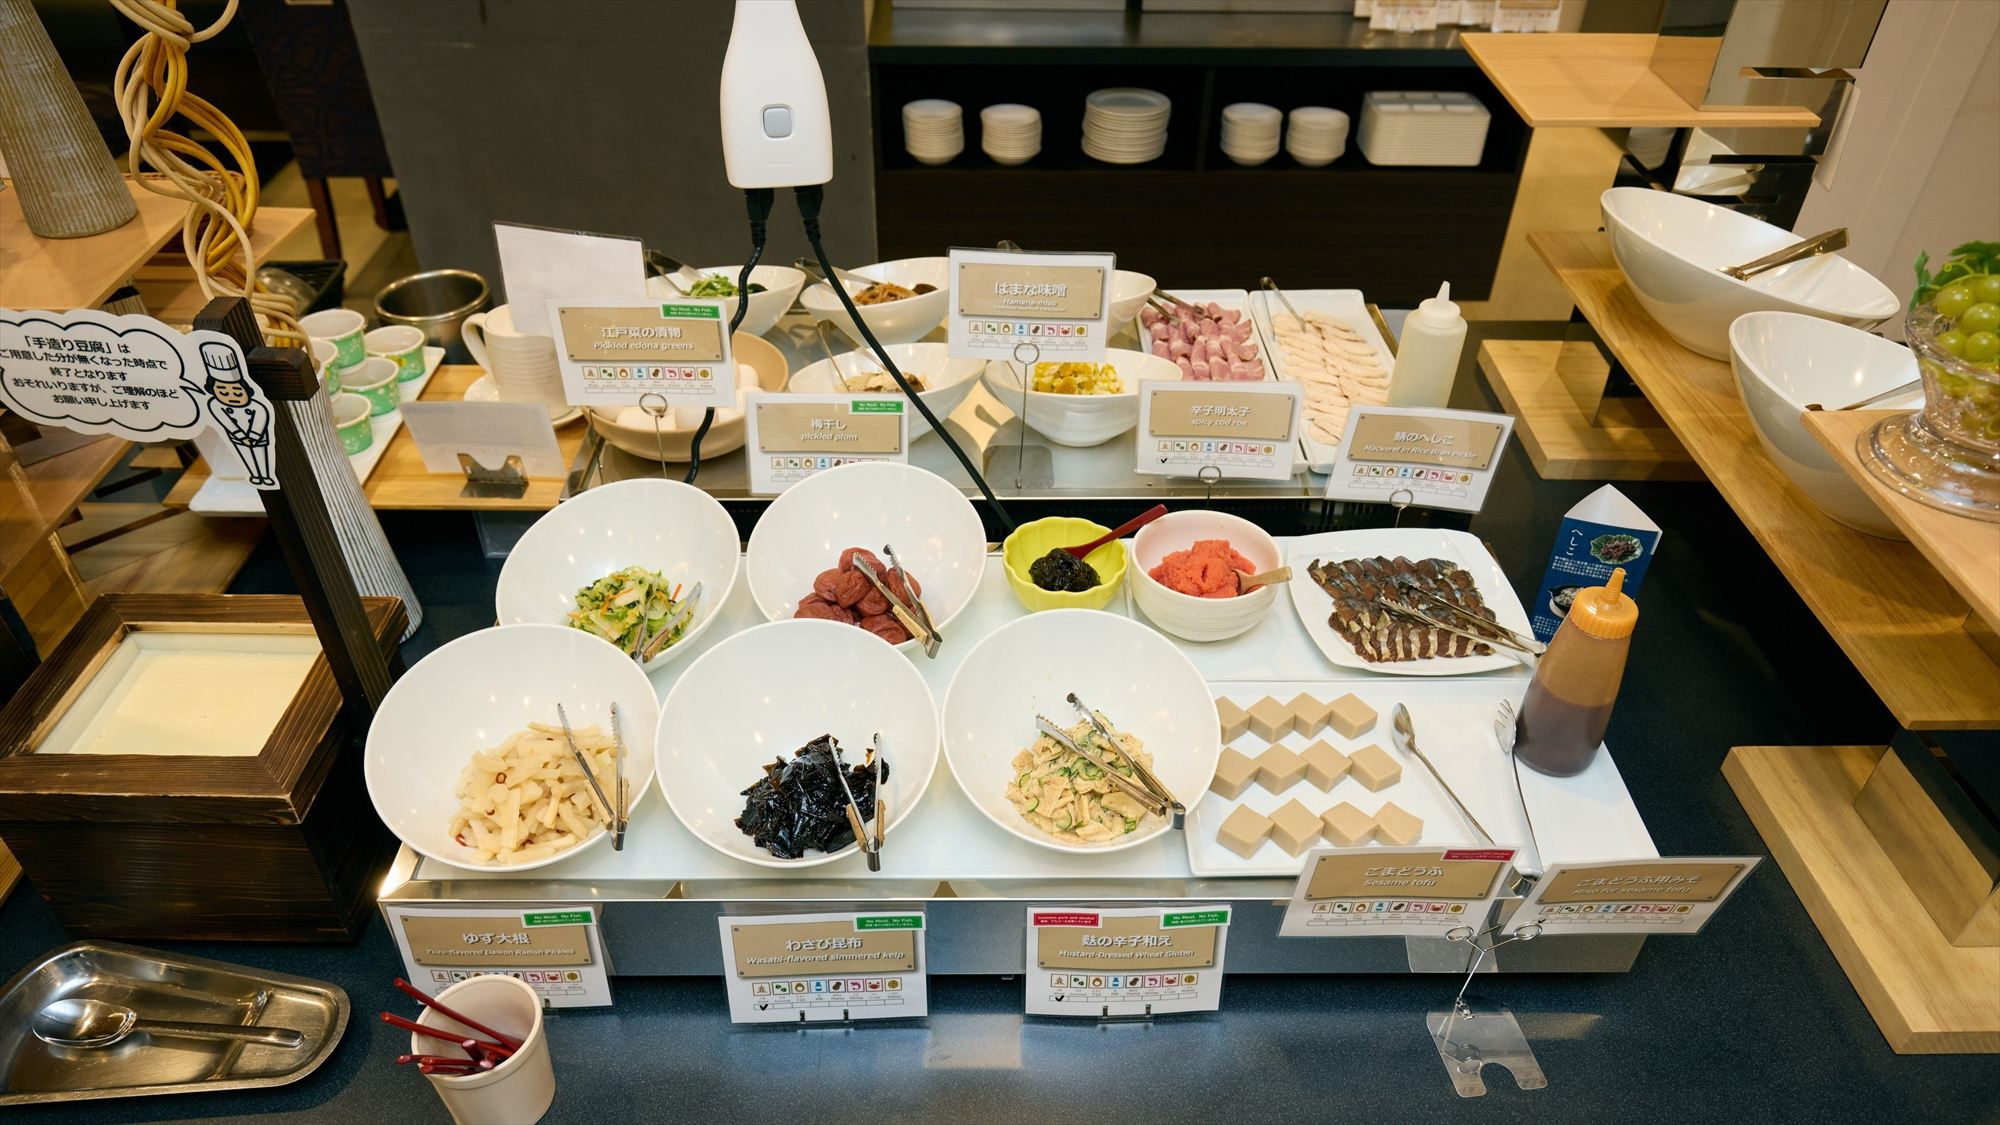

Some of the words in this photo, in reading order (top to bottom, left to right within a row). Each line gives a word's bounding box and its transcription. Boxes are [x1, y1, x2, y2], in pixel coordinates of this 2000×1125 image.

[995, 282, 1067, 297] はまな味噌
[593, 341, 628, 350] Pickled
[50, 367, 127, 382] 終了となります
[12, 377, 180, 399] おそれいりますが、ご理解のほど
[52, 394, 151, 411] お願い申し上げます
[1191, 404, 1250, 417] 辛子明太子
[811, 418, 848, 431] 梅干し
[801, 432, 834, 442] pickled
[835, 433, 859, 442] plum
[1565, 528, 1583, 556] へしこ
[1364, 866, 1444, 877] ごまどうふ
[462, 932, 531, 945] ゆず大根
[786, 936, 863, 951] わさび昆布
[746, 953, 828, 965] Wasabi-flavored
[831, 951, 882, 961] simmered
[882, 951, 906, 960] kelp
